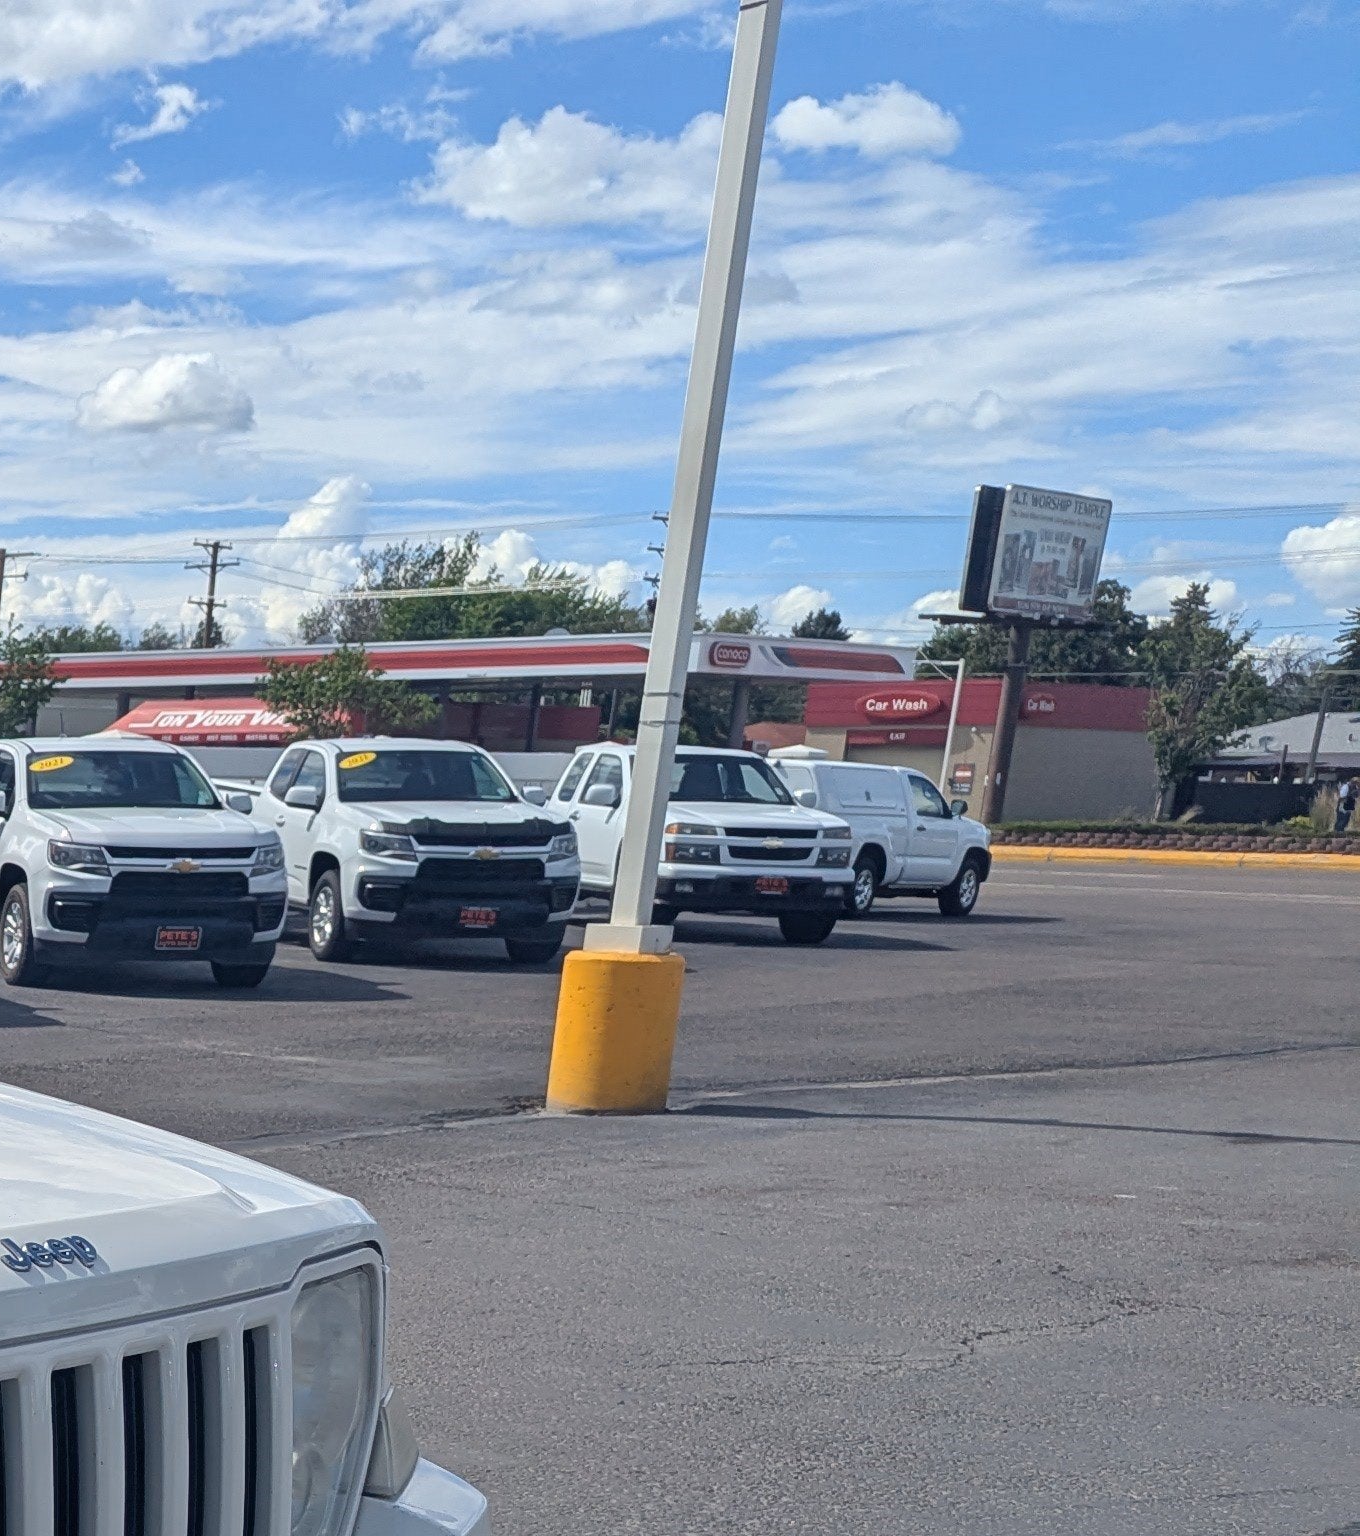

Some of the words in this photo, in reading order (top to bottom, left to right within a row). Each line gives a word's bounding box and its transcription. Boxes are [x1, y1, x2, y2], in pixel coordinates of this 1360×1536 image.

[1031, 494, 1072, 511] WORSHIP
[1074, 501, 1105, 518] TEMPLE
[865, 699, 887, 711] Car
[892, 699, 928, 711] Wash
[0, 1235, 97, 1273] Jeep
